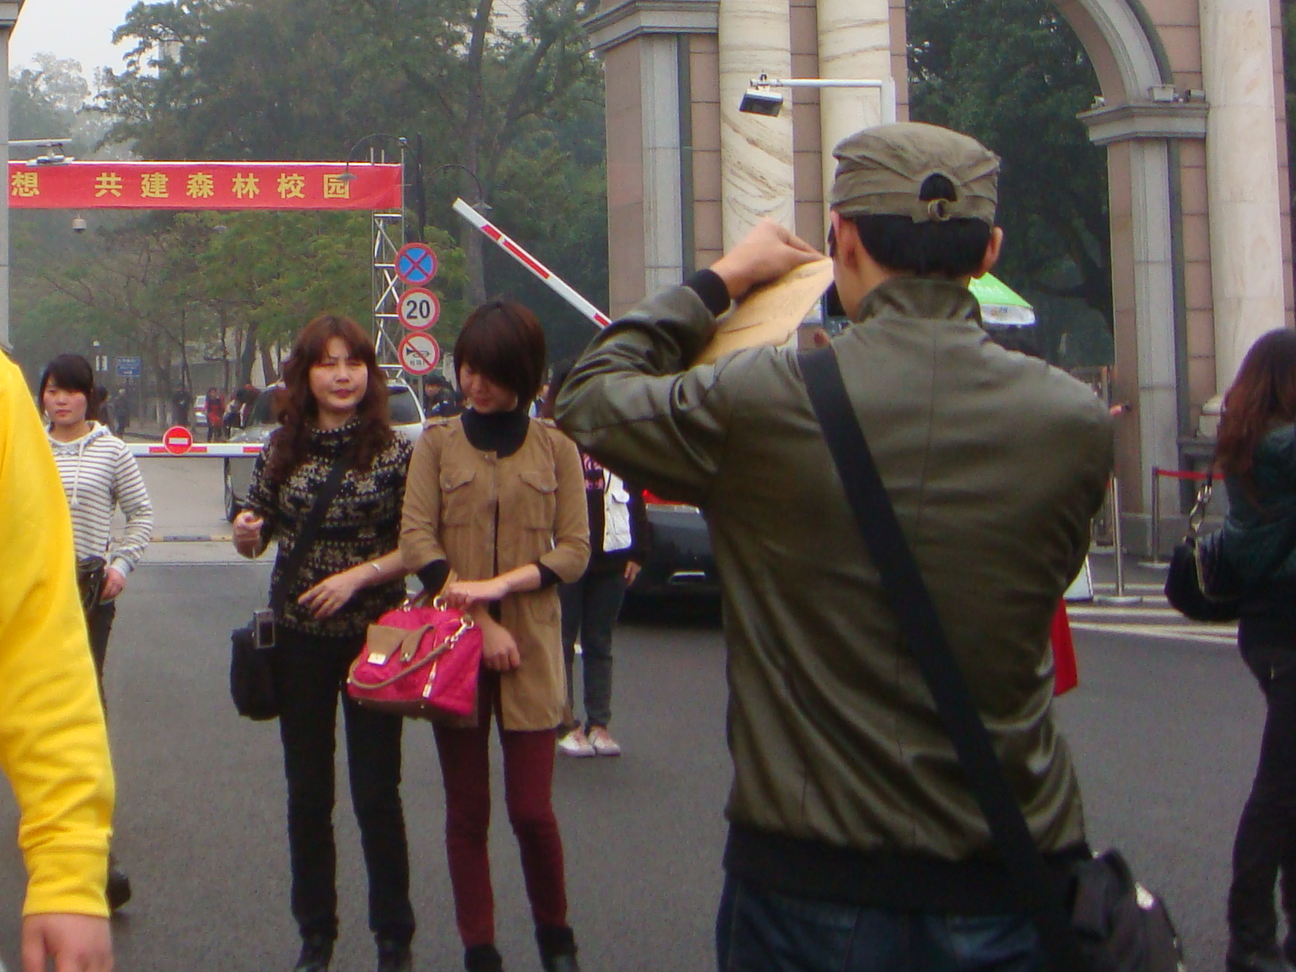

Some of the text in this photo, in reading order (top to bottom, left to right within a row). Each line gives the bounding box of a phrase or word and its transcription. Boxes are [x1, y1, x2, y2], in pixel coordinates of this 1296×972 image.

[11, 172, 351, 199] 想 共建森林校园
[406, 300, 431, 319] 20
